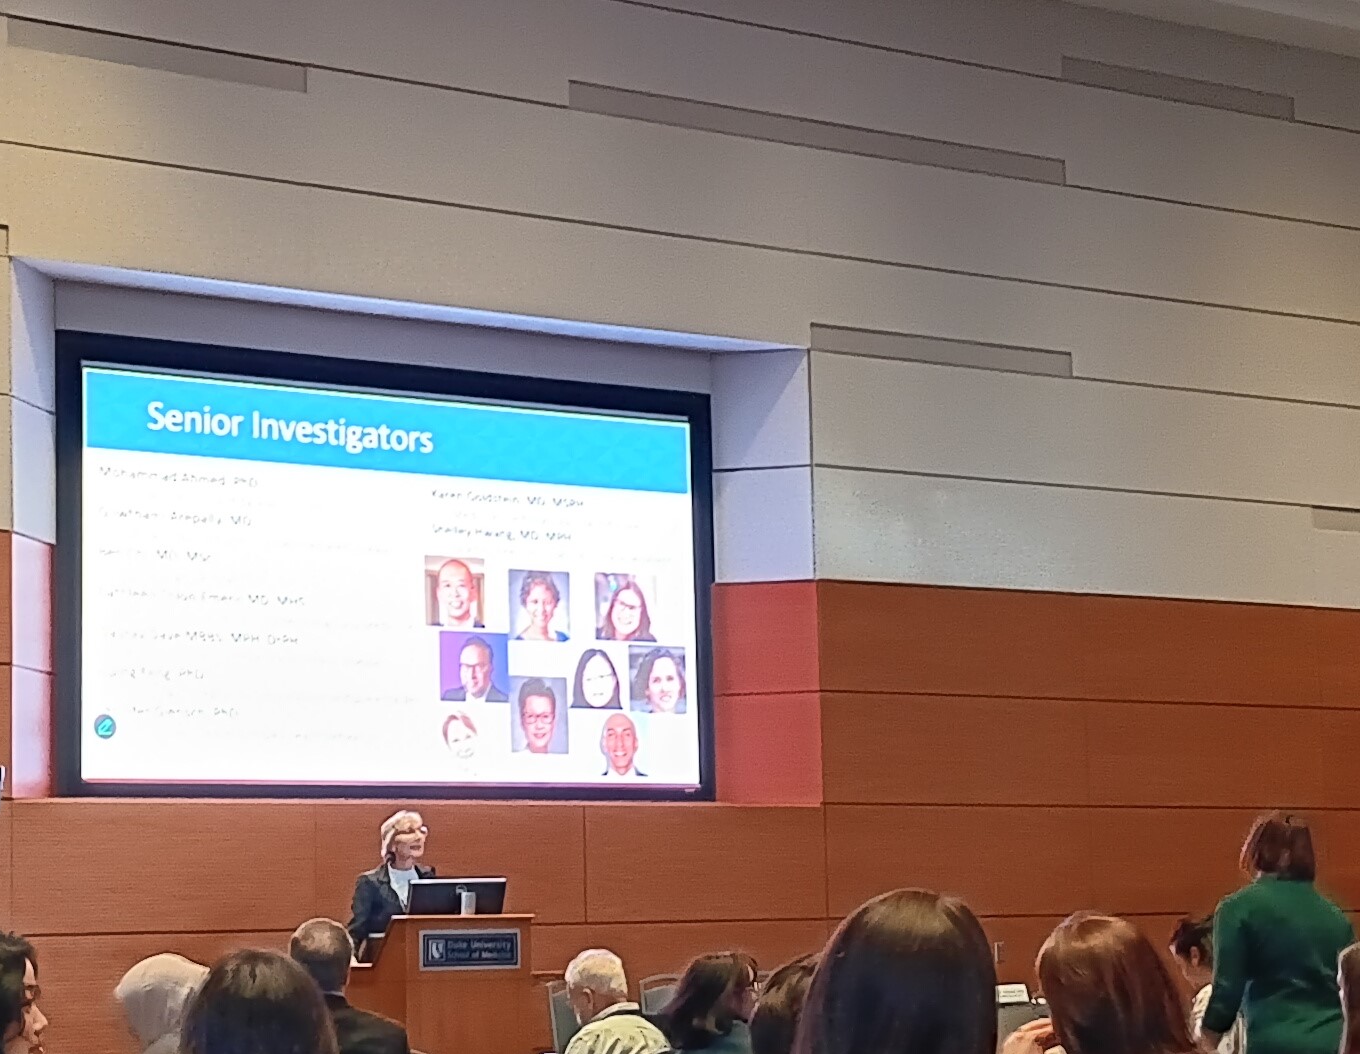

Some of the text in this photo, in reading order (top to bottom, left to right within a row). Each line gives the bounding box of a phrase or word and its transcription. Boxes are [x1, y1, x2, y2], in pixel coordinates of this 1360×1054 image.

[147, 401, 434, 454] Senior Investigators
[470, 940, 511, 951] University
